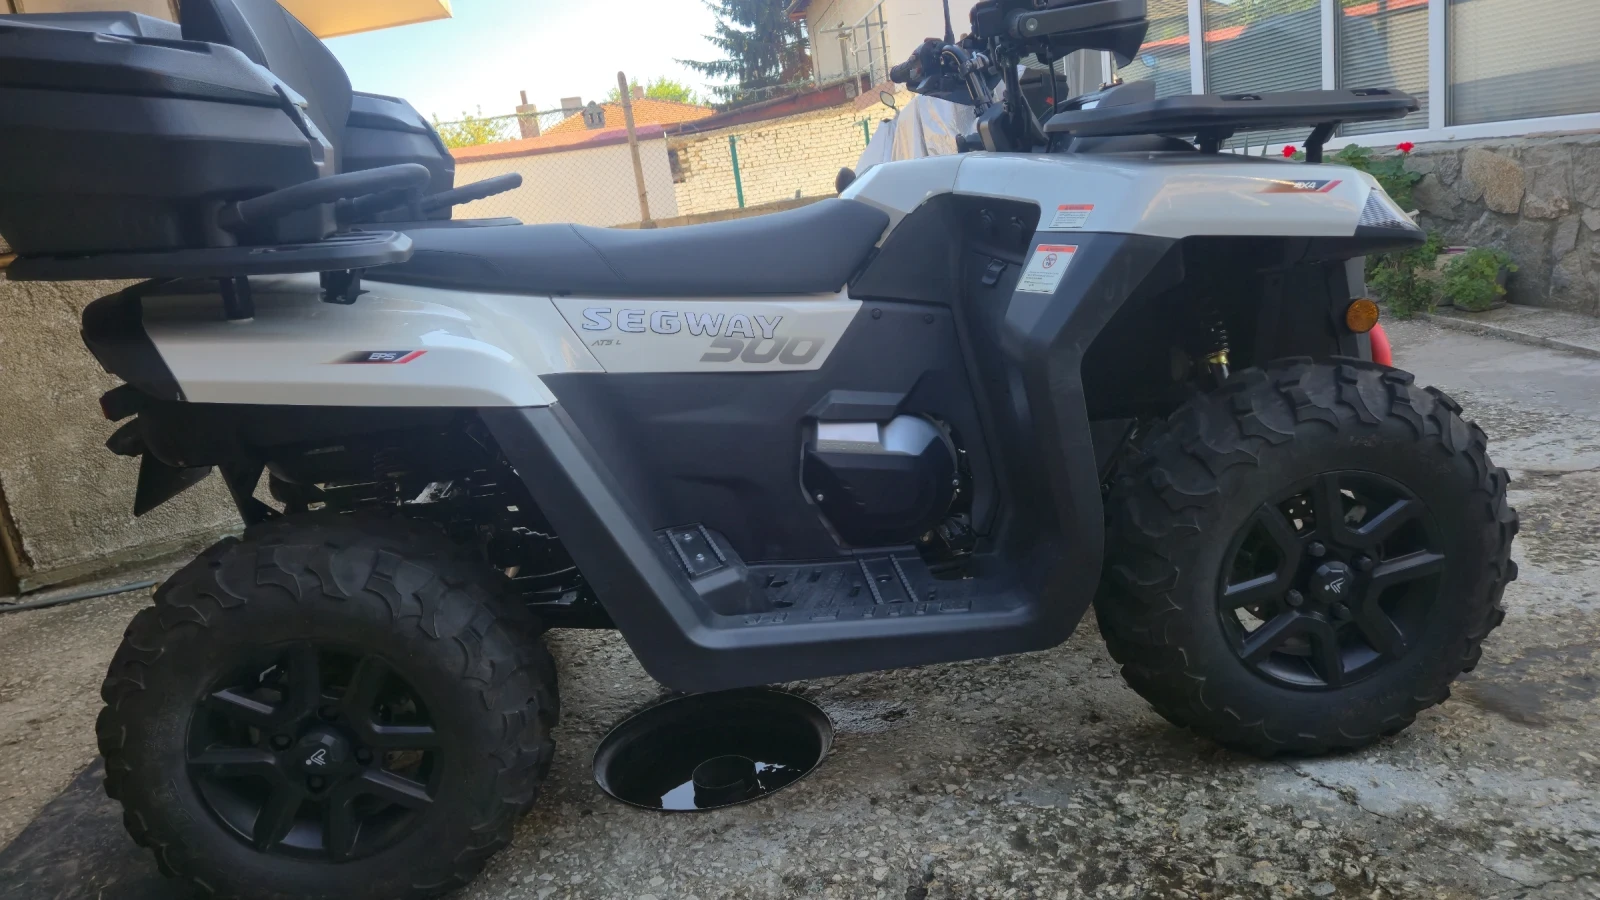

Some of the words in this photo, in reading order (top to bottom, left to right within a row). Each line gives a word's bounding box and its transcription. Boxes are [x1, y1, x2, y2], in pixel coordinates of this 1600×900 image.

[581, 307, 784, 340] SEGWAY
[368, 352, 397, 360] EPS
[700, 335, 826, 365] 500
